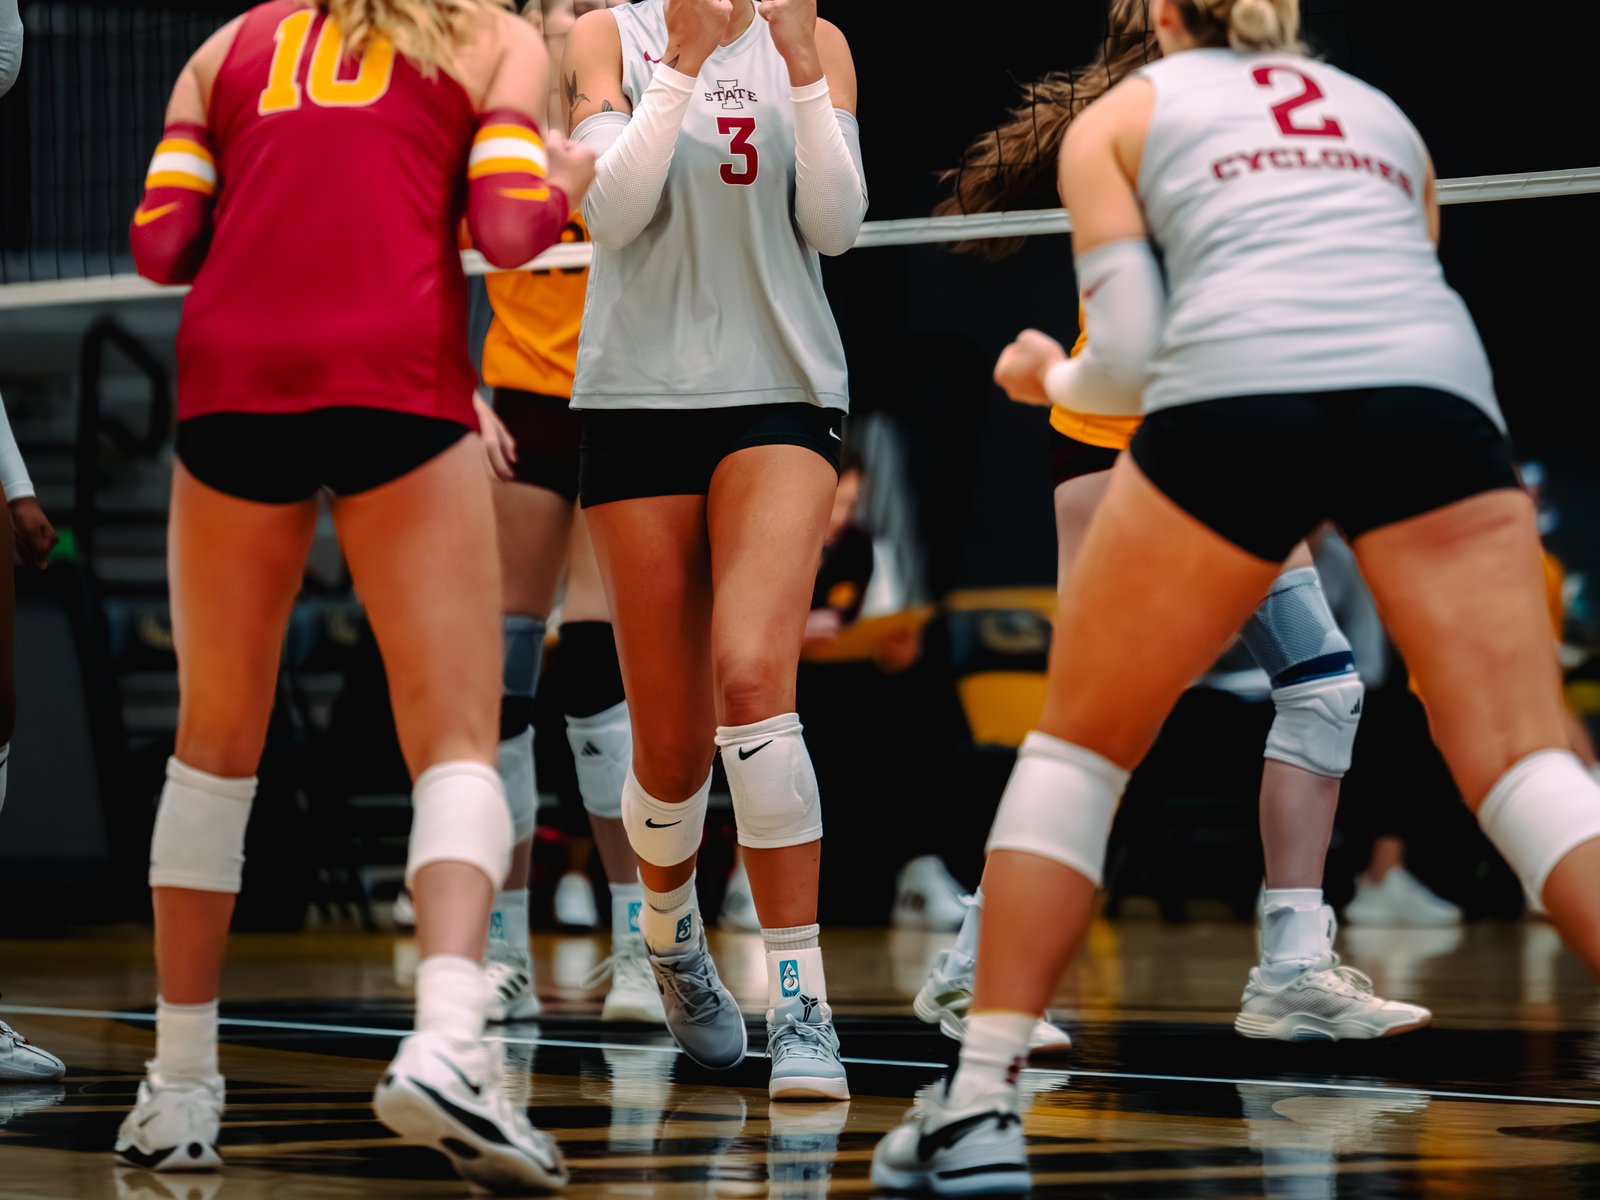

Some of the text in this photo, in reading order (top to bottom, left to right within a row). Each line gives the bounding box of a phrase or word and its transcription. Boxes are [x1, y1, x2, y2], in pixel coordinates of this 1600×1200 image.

[258, 8, 396, 117] 10
[704, 87, 758, 103] STATE
[1252, 65, 1345, 139] 2
[716, 116, 759, 186] 3
